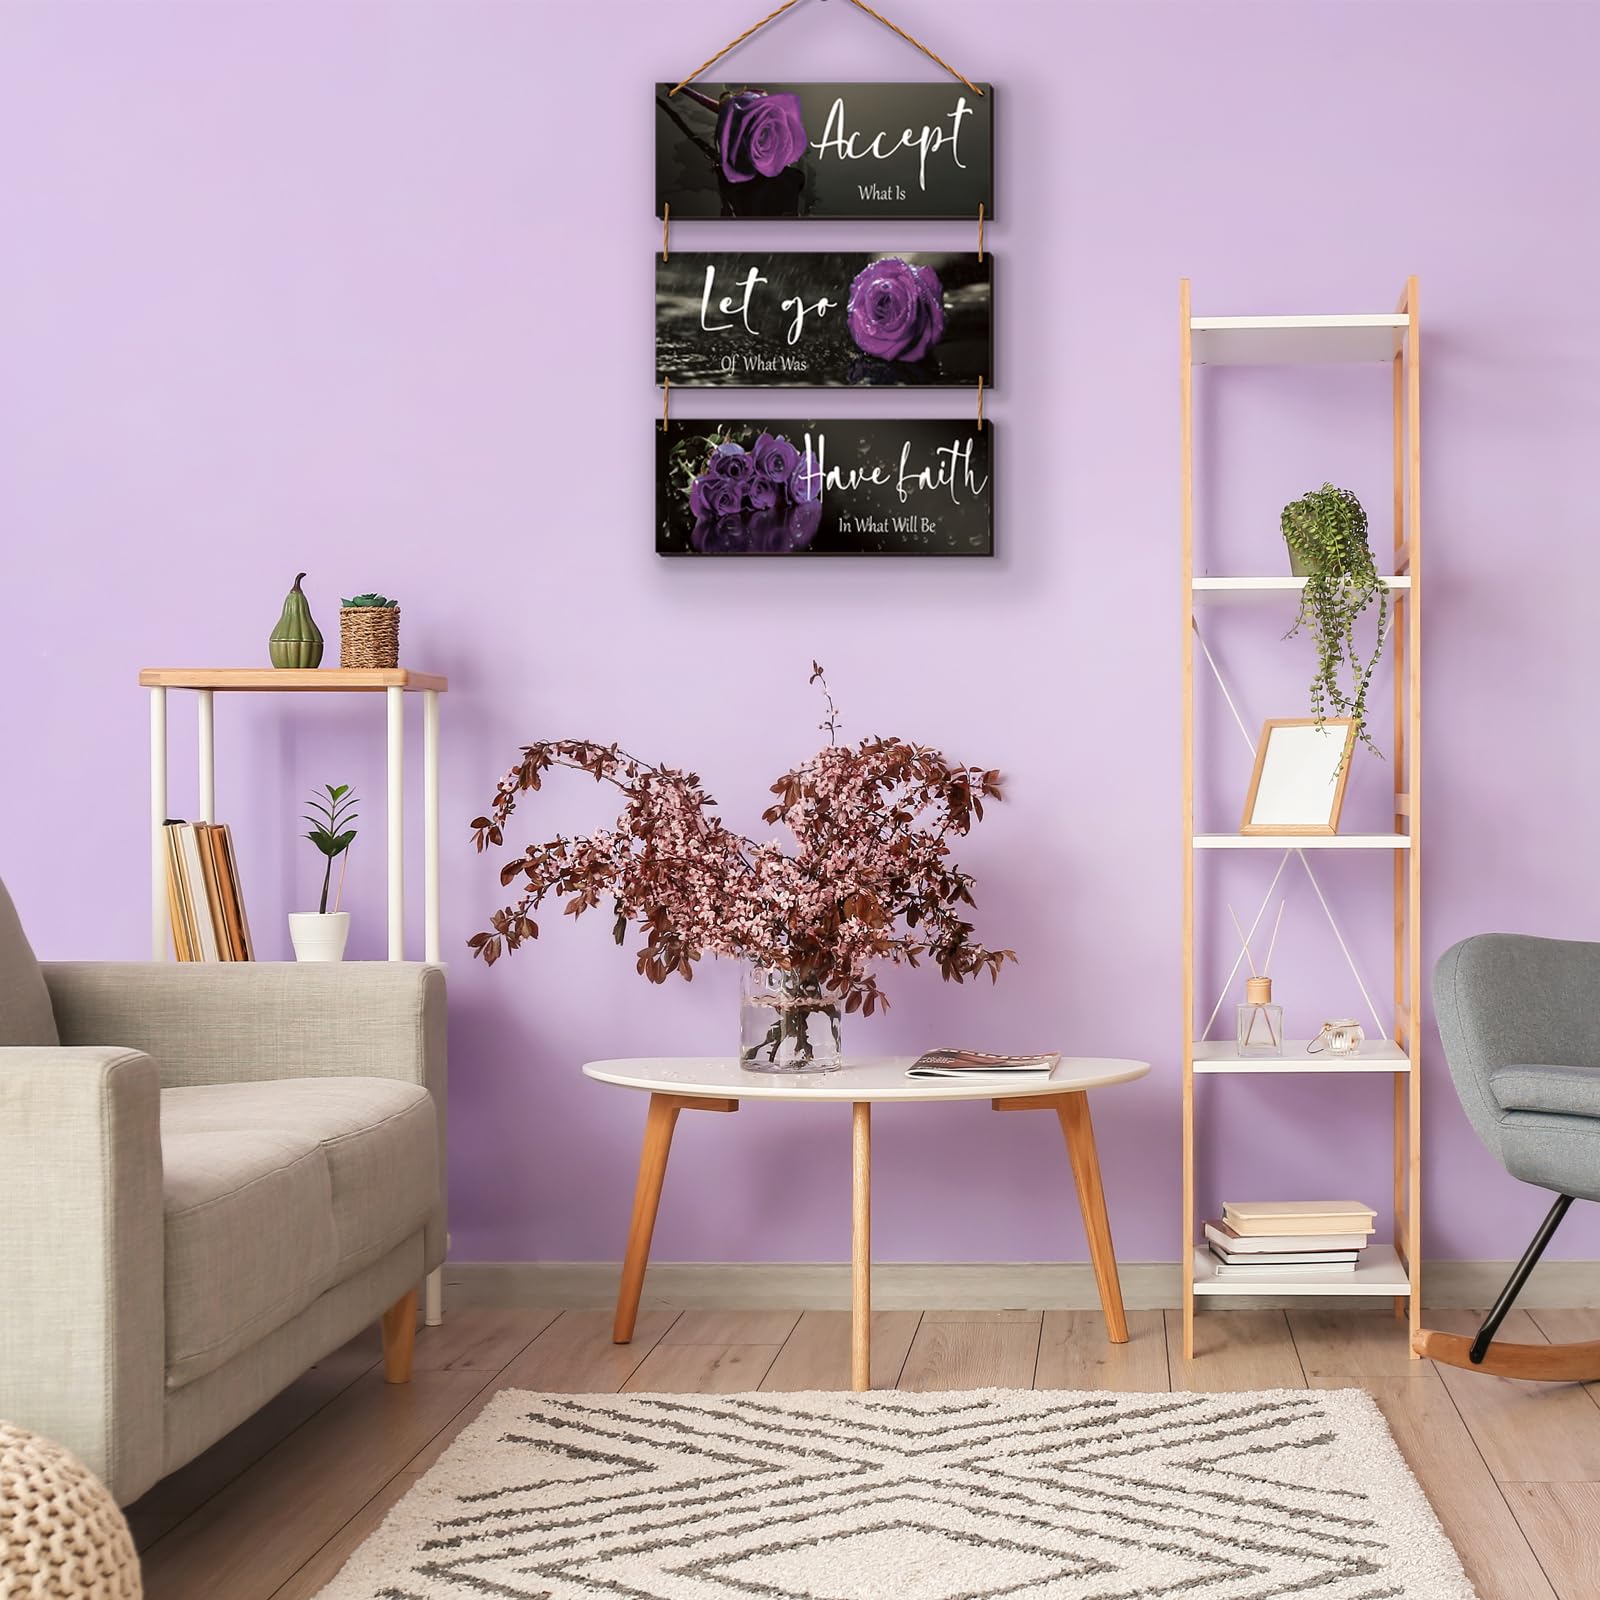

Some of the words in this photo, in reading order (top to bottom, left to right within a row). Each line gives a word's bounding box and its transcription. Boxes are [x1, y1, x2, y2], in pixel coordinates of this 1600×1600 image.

[810, 97, 973, 191] Accept
[858, 183, 892, 201] What
[896, 185, 906, 201] Is
[700, 265, 768, 335] Let
[781, 296, 838, 345] go
[721, 354, 740, 376] Of
[743, 355, 778, 372] What
[780, 356, 808, 372] Was
[798, 433, 891, 503] Have
[896, 438, 988, 505] faith
[839, 518, 851, 533] In
[853, 517, 889, 533] What
[891, 516, 918, 533] Will
[921, 518, 937, 534] Be
